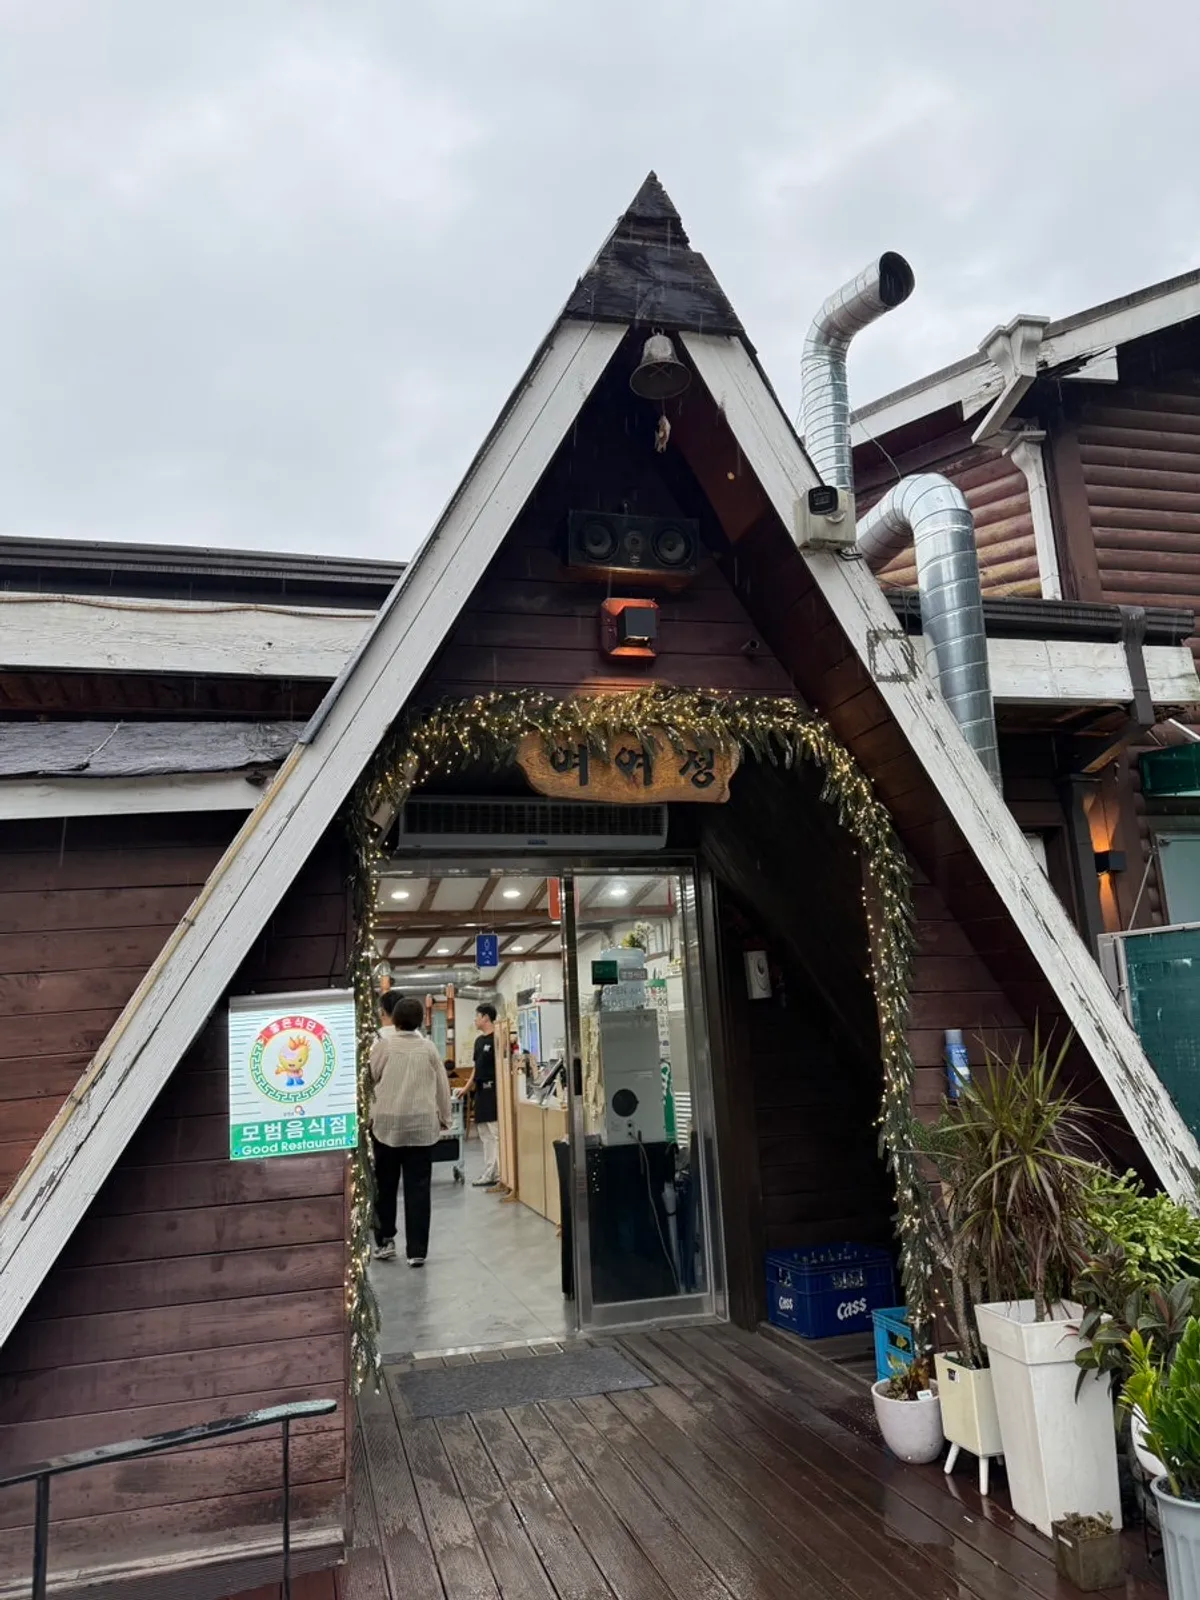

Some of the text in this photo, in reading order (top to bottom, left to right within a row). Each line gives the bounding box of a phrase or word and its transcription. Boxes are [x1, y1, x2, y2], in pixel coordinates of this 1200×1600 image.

[241, 1115, 347, 1142] 모범음식점
[241, 1136, 346, 1156] Good Restaurant
[778, 1296, 794, 1310] Cass
[837, 1297, 867, 1321] Cass
